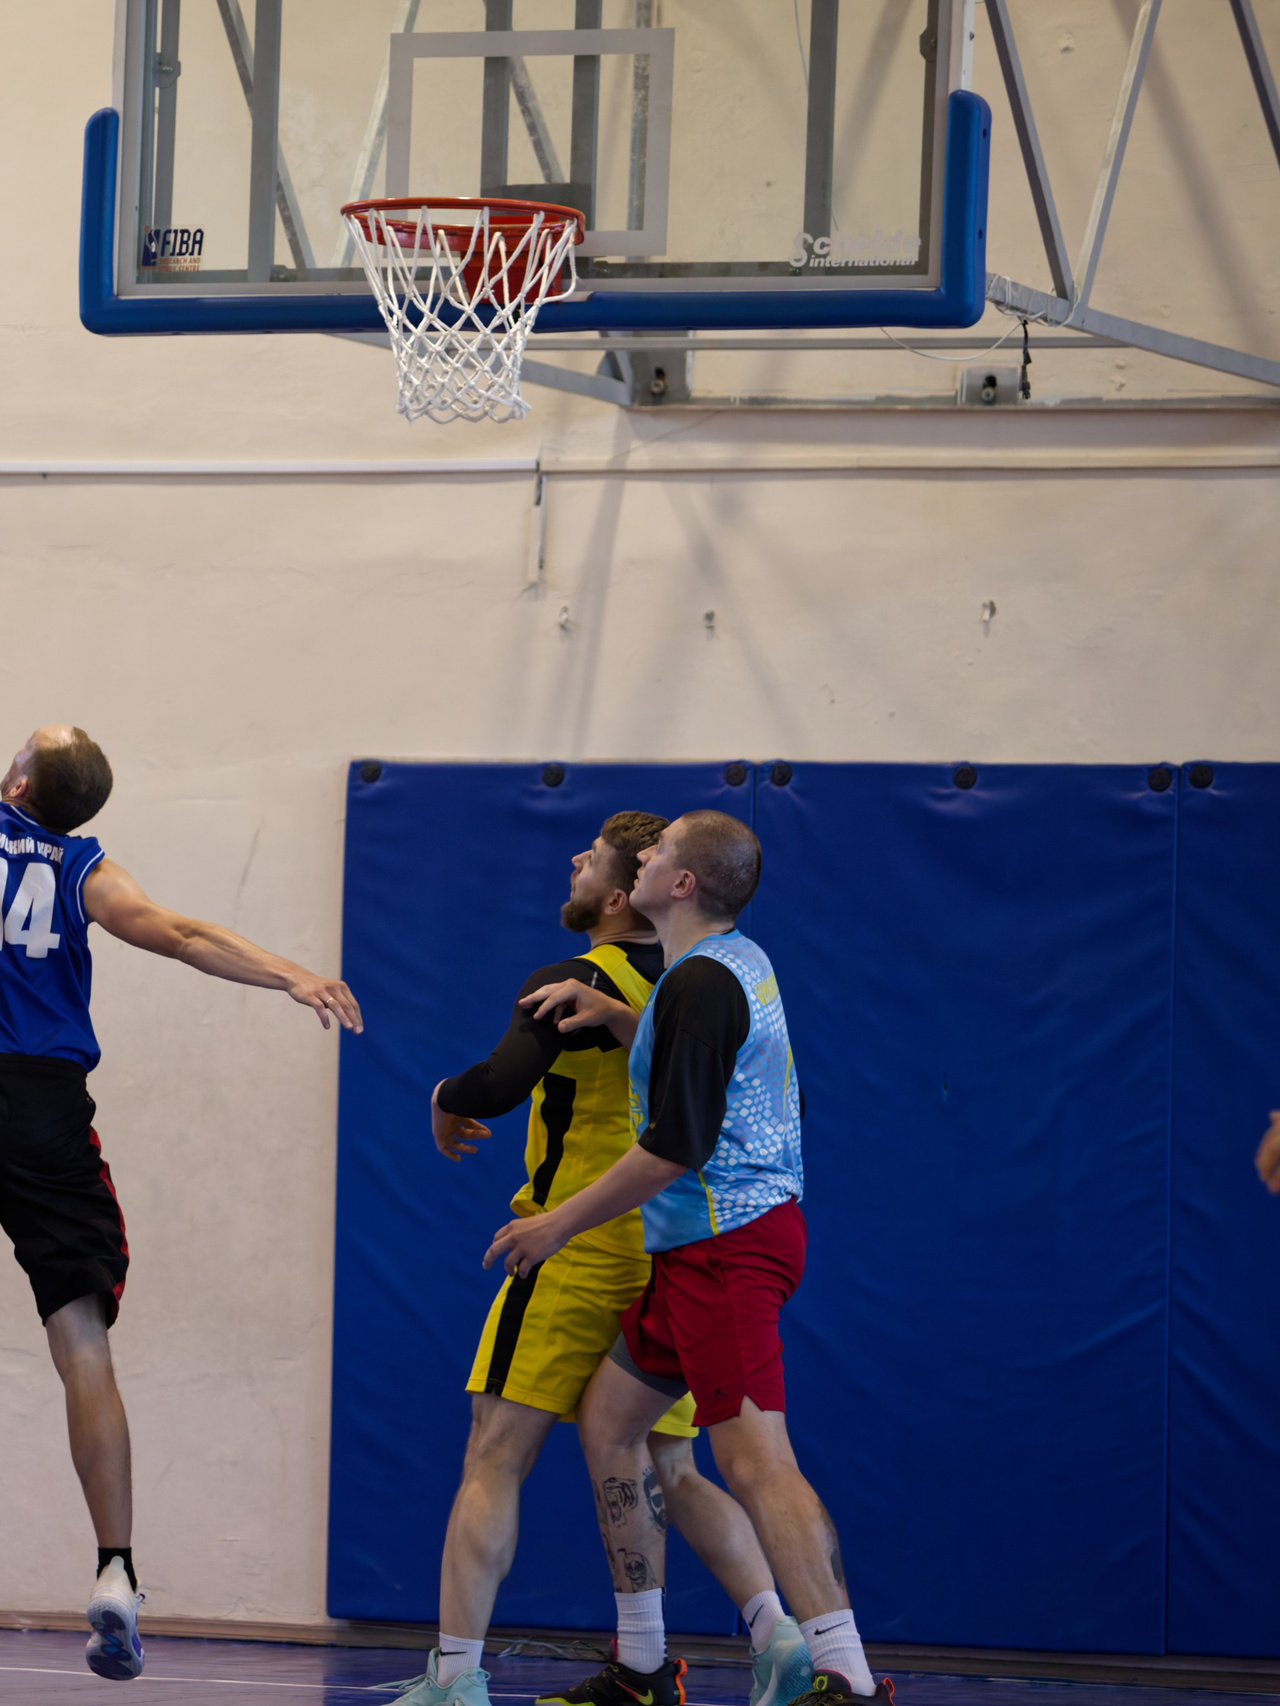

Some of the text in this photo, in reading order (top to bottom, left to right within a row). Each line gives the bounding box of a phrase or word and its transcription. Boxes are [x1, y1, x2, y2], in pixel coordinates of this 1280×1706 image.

[160, 228, 204, 257] FIBA
[789, 230, 921, 267] Schelde
[809, 255, 918, 268] international
